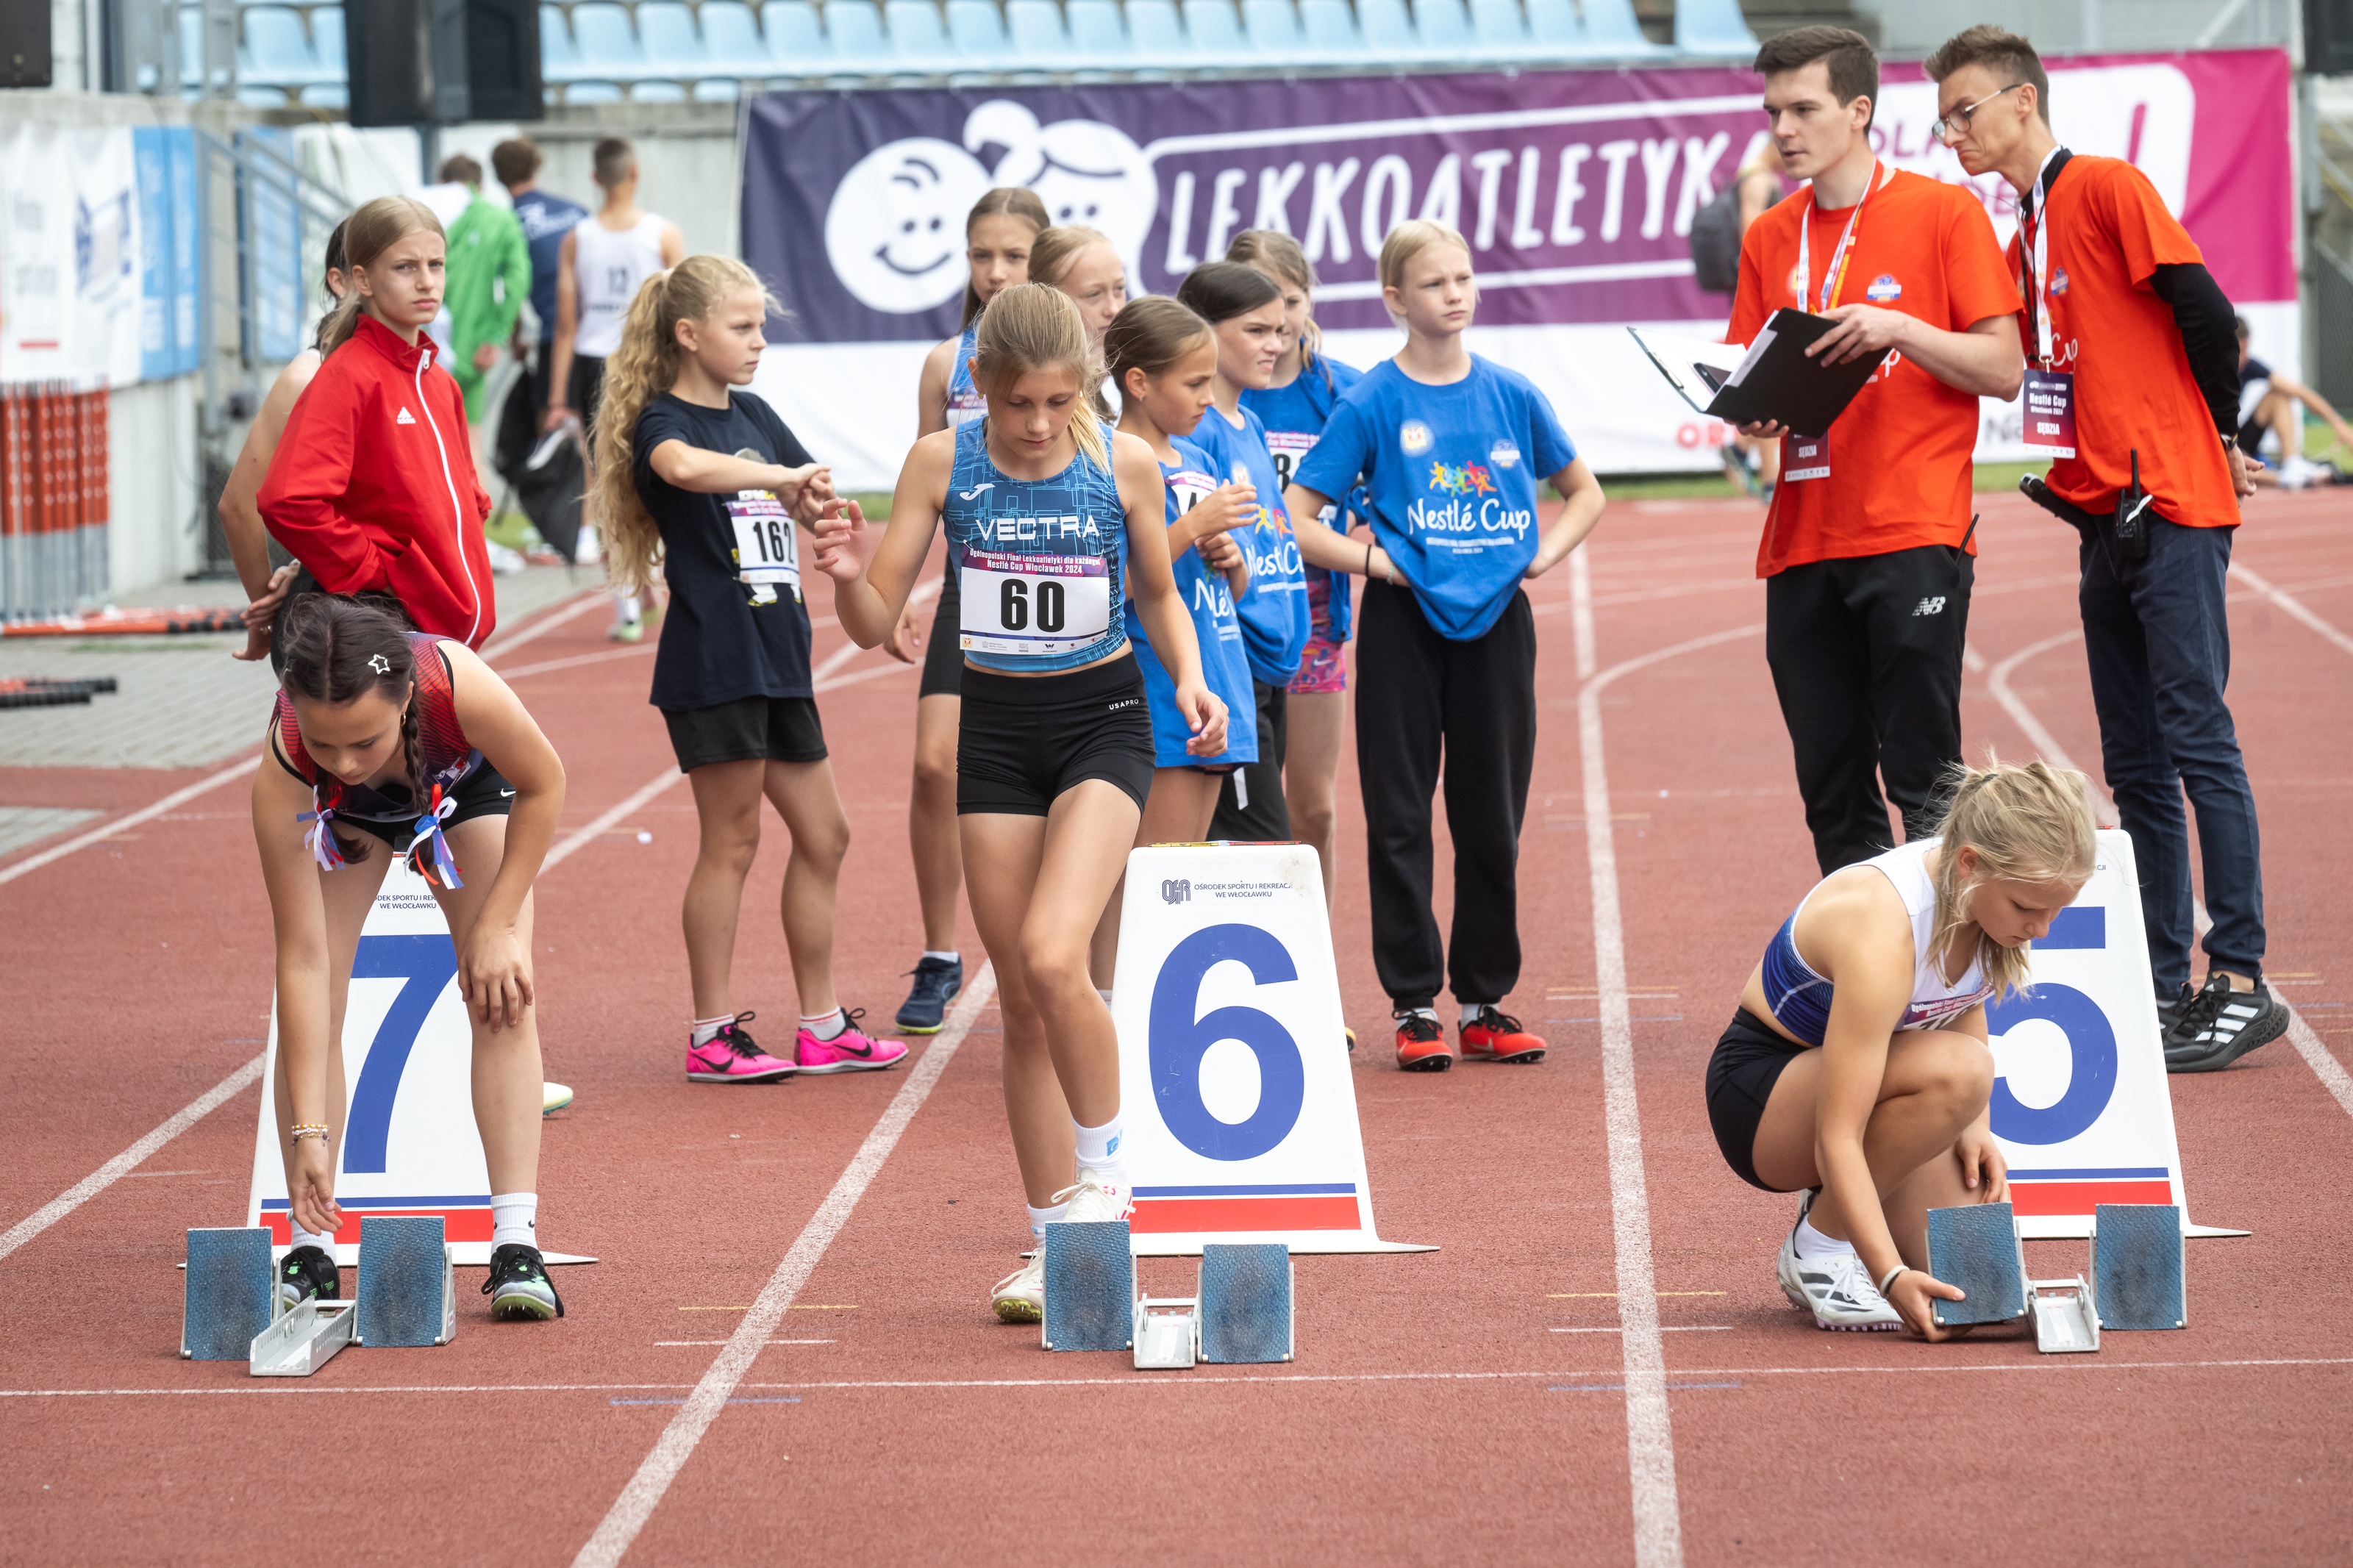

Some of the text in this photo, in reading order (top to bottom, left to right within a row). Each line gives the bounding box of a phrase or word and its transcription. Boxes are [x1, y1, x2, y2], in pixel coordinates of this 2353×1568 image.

[2053, 395, 2066, 409] Cup
[2037, 421, 2060, 436] SĘDZIA
[1799, 445, 1817, 459] SĘDZIA
[975, 515, 1100, 541] VECTRA
[1407, 498, 1531, 541] Nestlé Cup
[753, 520, 794, 565] 162
[970, 549, 1006, 561] Ogólnopolski
[1007, 554, 1021, 562] Finał
[1023, 556, 1063, 565] Lekkoatletyki
[987, 560, 1082, 574] Nestlé Cup Włocławek 2024
[1246, 544, 1285, 579] Nest
[1001, 578, 1065, 633] 60
[1149, 922, 1305, 1162] 6
[1987, 906, 2118, 1146] 5
[343, 934, 459, 1174] 7
